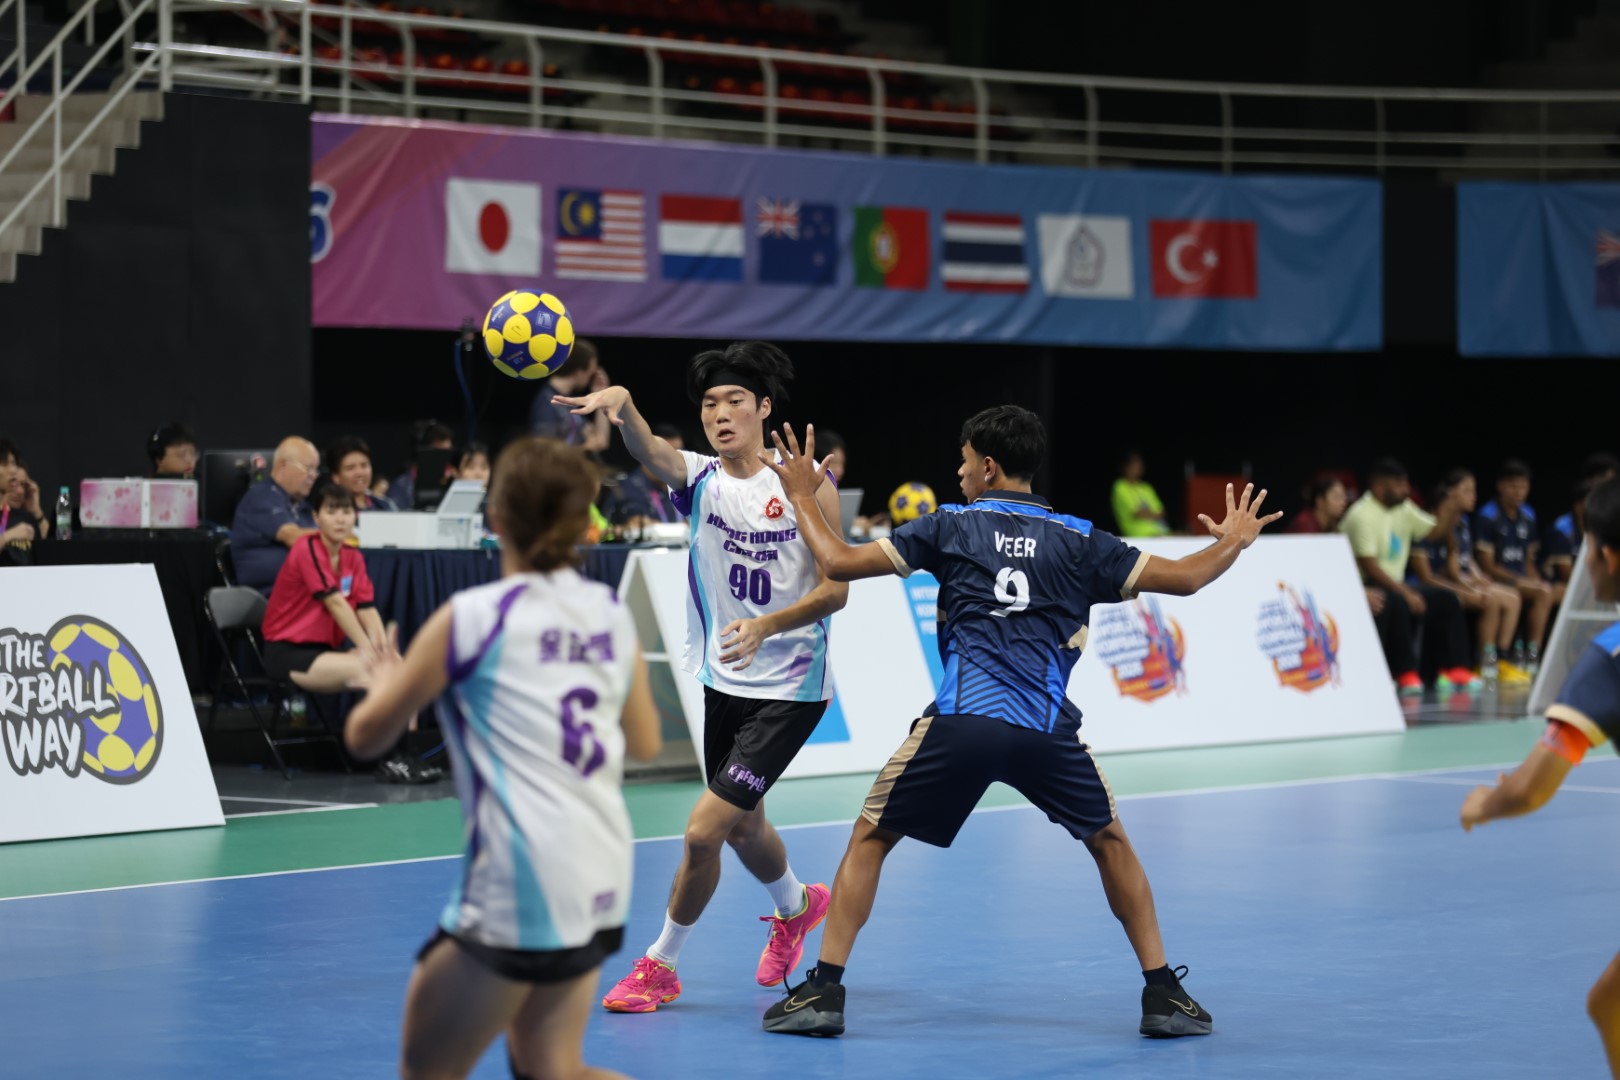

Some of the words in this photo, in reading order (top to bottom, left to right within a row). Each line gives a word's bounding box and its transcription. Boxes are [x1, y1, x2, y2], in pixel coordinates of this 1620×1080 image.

[994, 531, 1037, 558] VEER
[729, 564, 772, 606] 90
[989, 566, 1030, 617] 9
[0, 634, 45, 673] THE
[0, 667, 116, 717] RFBALL
[6, 715, 81, 772] WAY
[560, 687, 606, 778] 6
